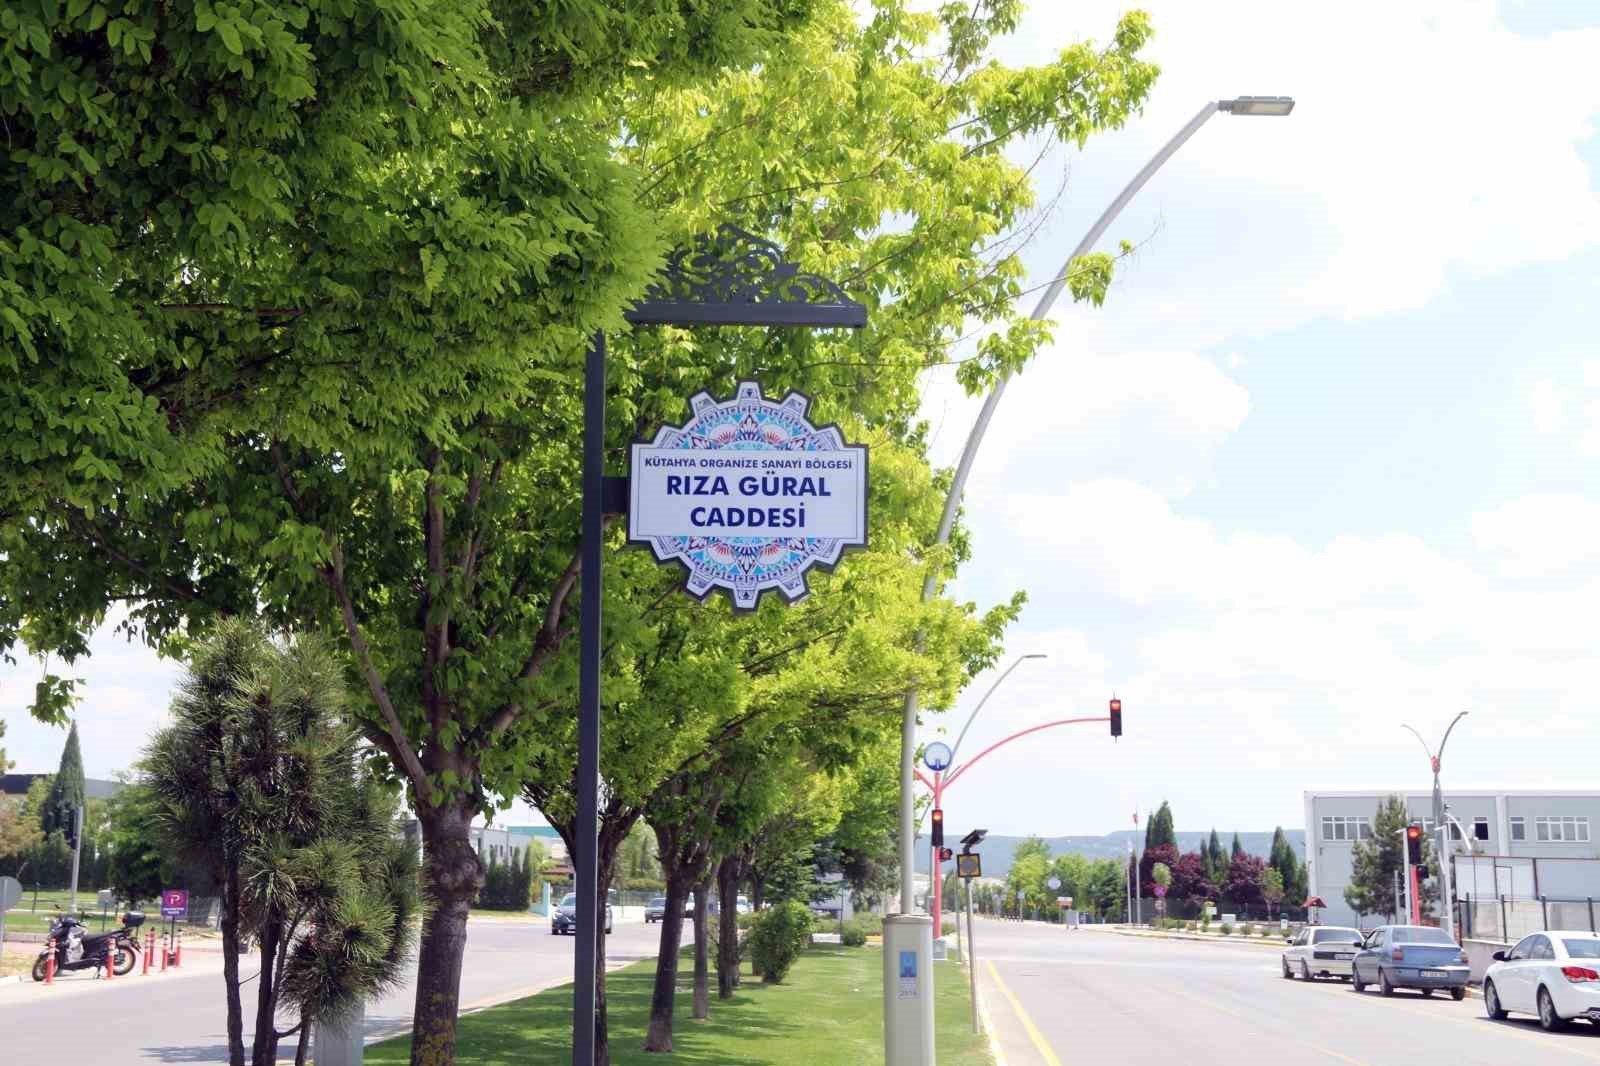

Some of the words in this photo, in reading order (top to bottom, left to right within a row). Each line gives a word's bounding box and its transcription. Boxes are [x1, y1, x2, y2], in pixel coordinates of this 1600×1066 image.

[644, 456, 697, 468] KÜTAHYA
[805, 457, 852, 470] BÖLGESİ
[666, 475, 730, 496] RIZA
[738, 470, 832, 497] GÜRAL
[690, 502, 806, 528] CADDESİ
